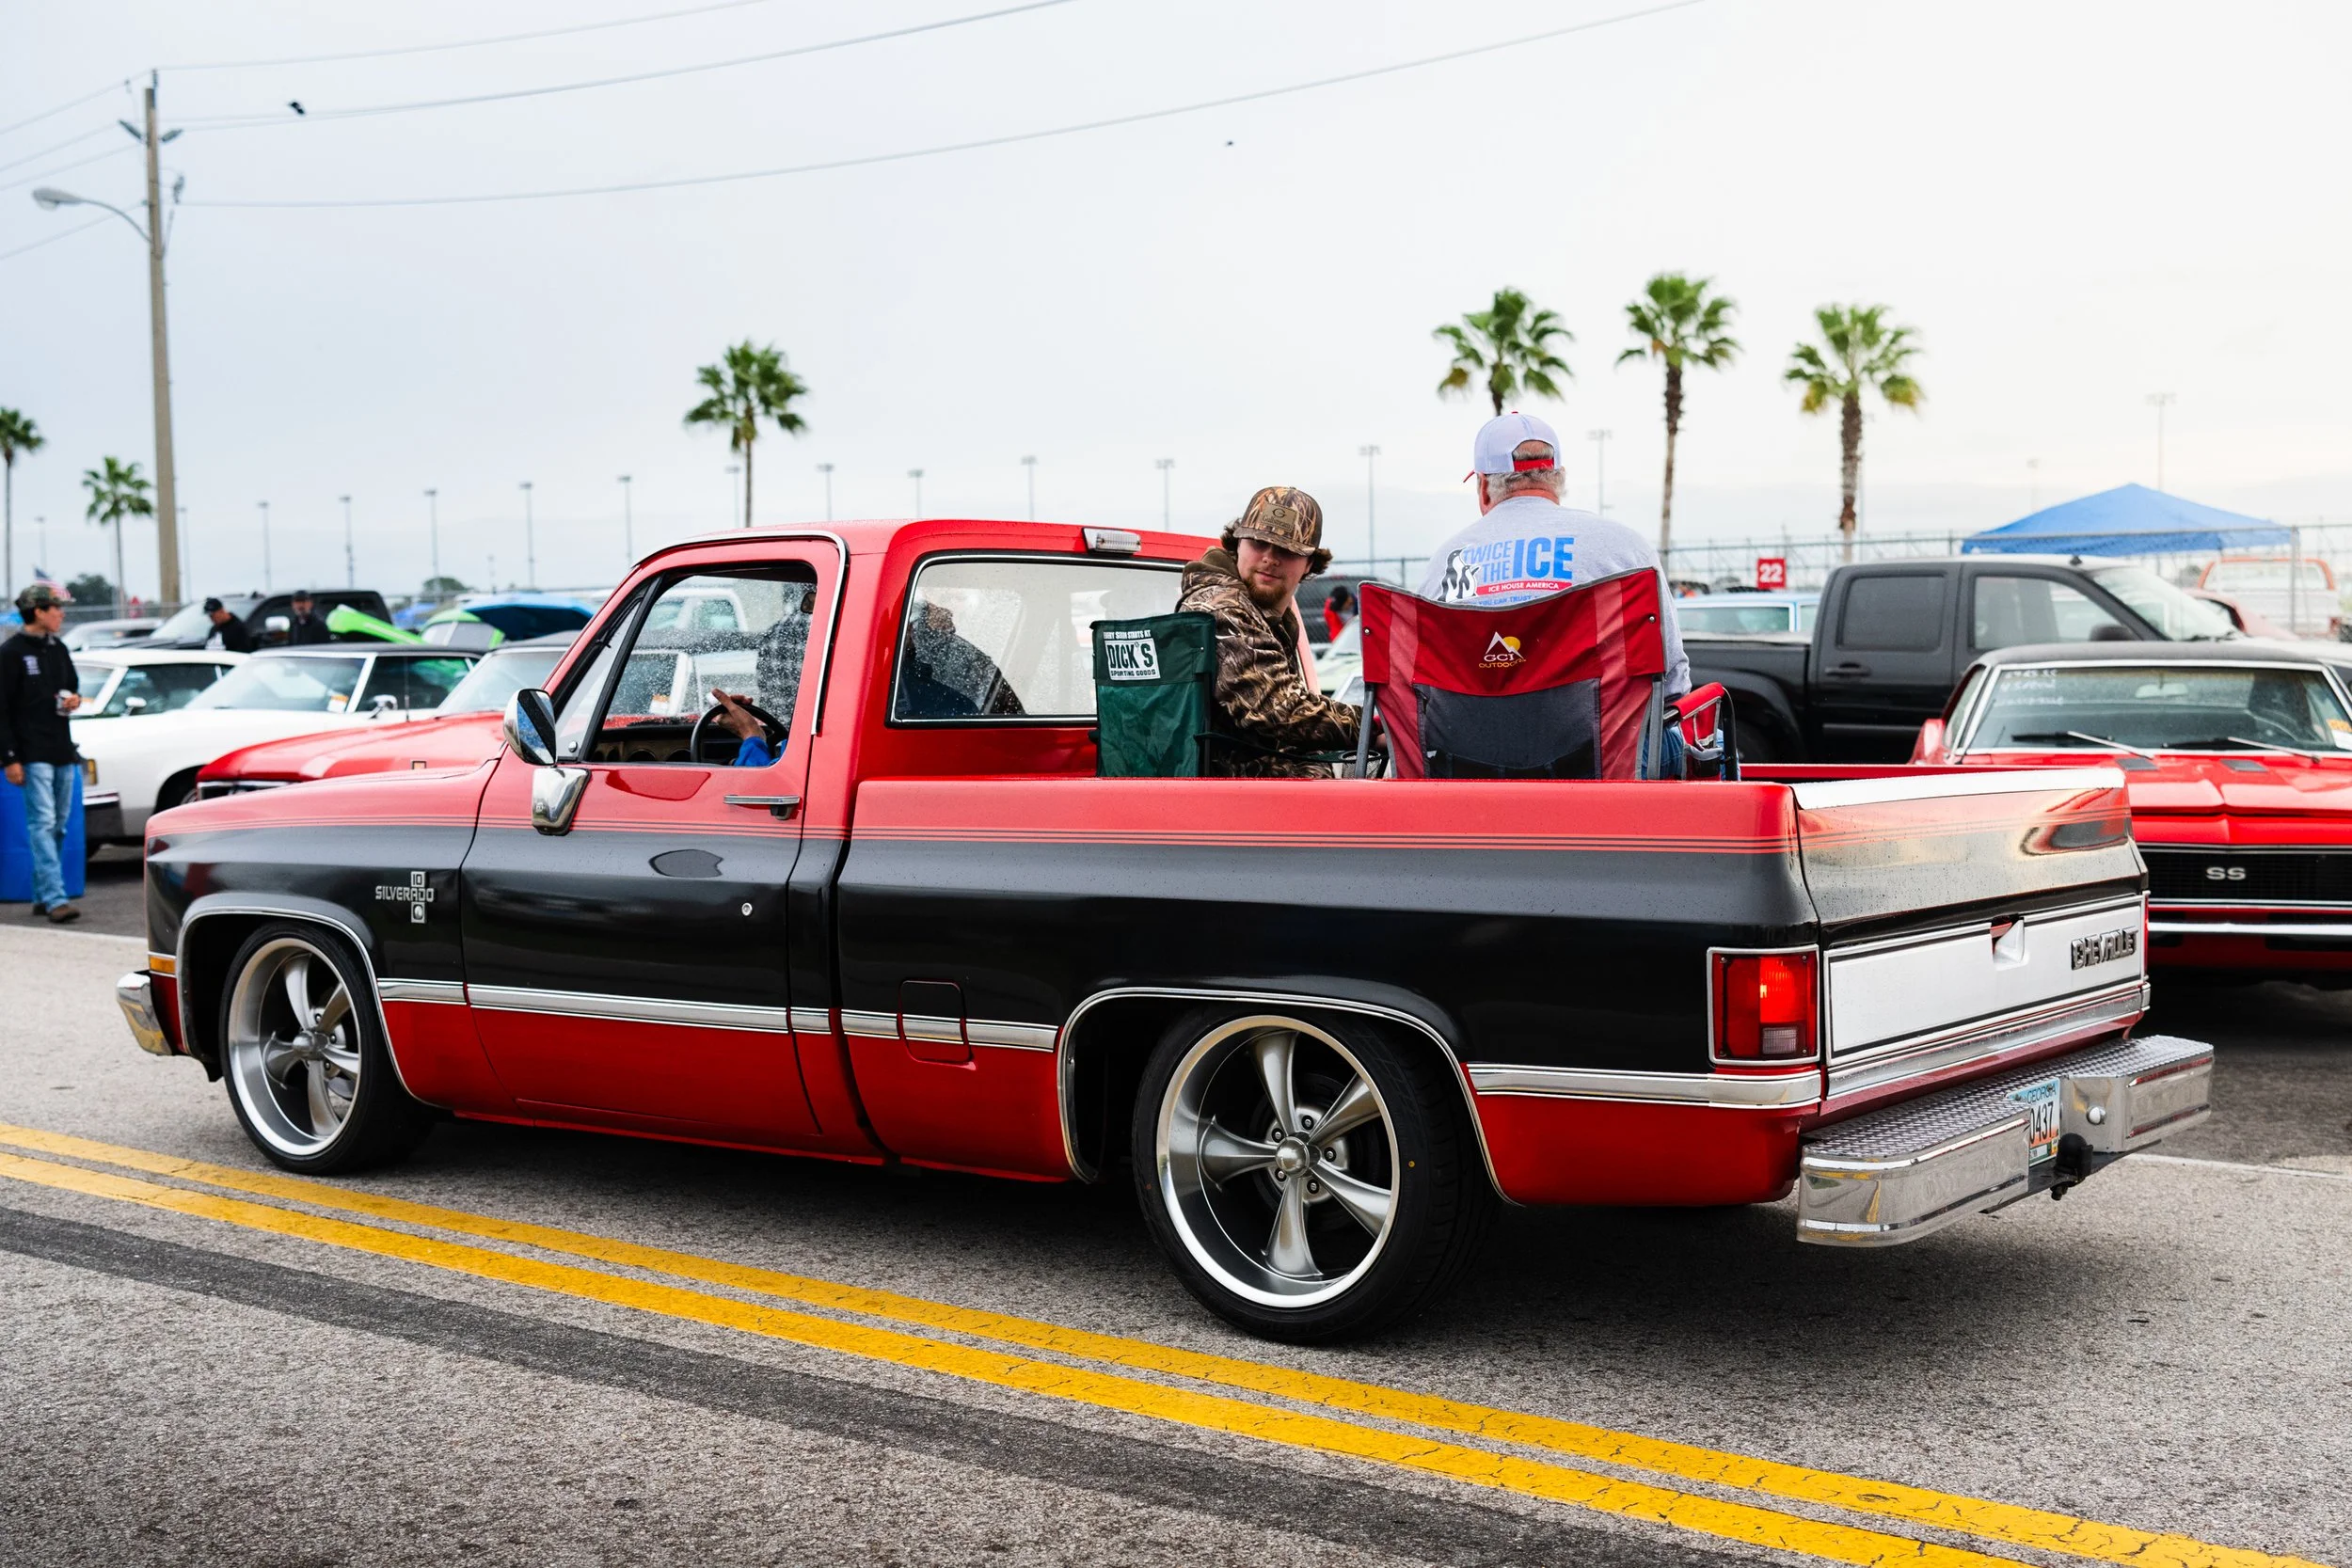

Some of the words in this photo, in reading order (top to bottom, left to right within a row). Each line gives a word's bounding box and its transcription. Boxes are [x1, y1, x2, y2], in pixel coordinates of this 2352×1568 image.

[1463, 541, 1512, 564] TWICE
[1512, 537, 1575, 580] ICE
[1482, 560, 1510, 583] THE
[1759, 562, 1784, 583] 22
[1502, 582, 1524, 591] HOUSE
[1526, 581, 1559, 590] AMERICA
[1106, 641, 1154, 669] DICK'S
[1484, 653, 1514, 662] GCI
[2205, 866, 2247, 881] SS
[374, 885, 435, 903] SILVERADO
[2071, 926, 2138, 970] CHEVROLET
[2029, 1101, 2054, 1145] 0437
